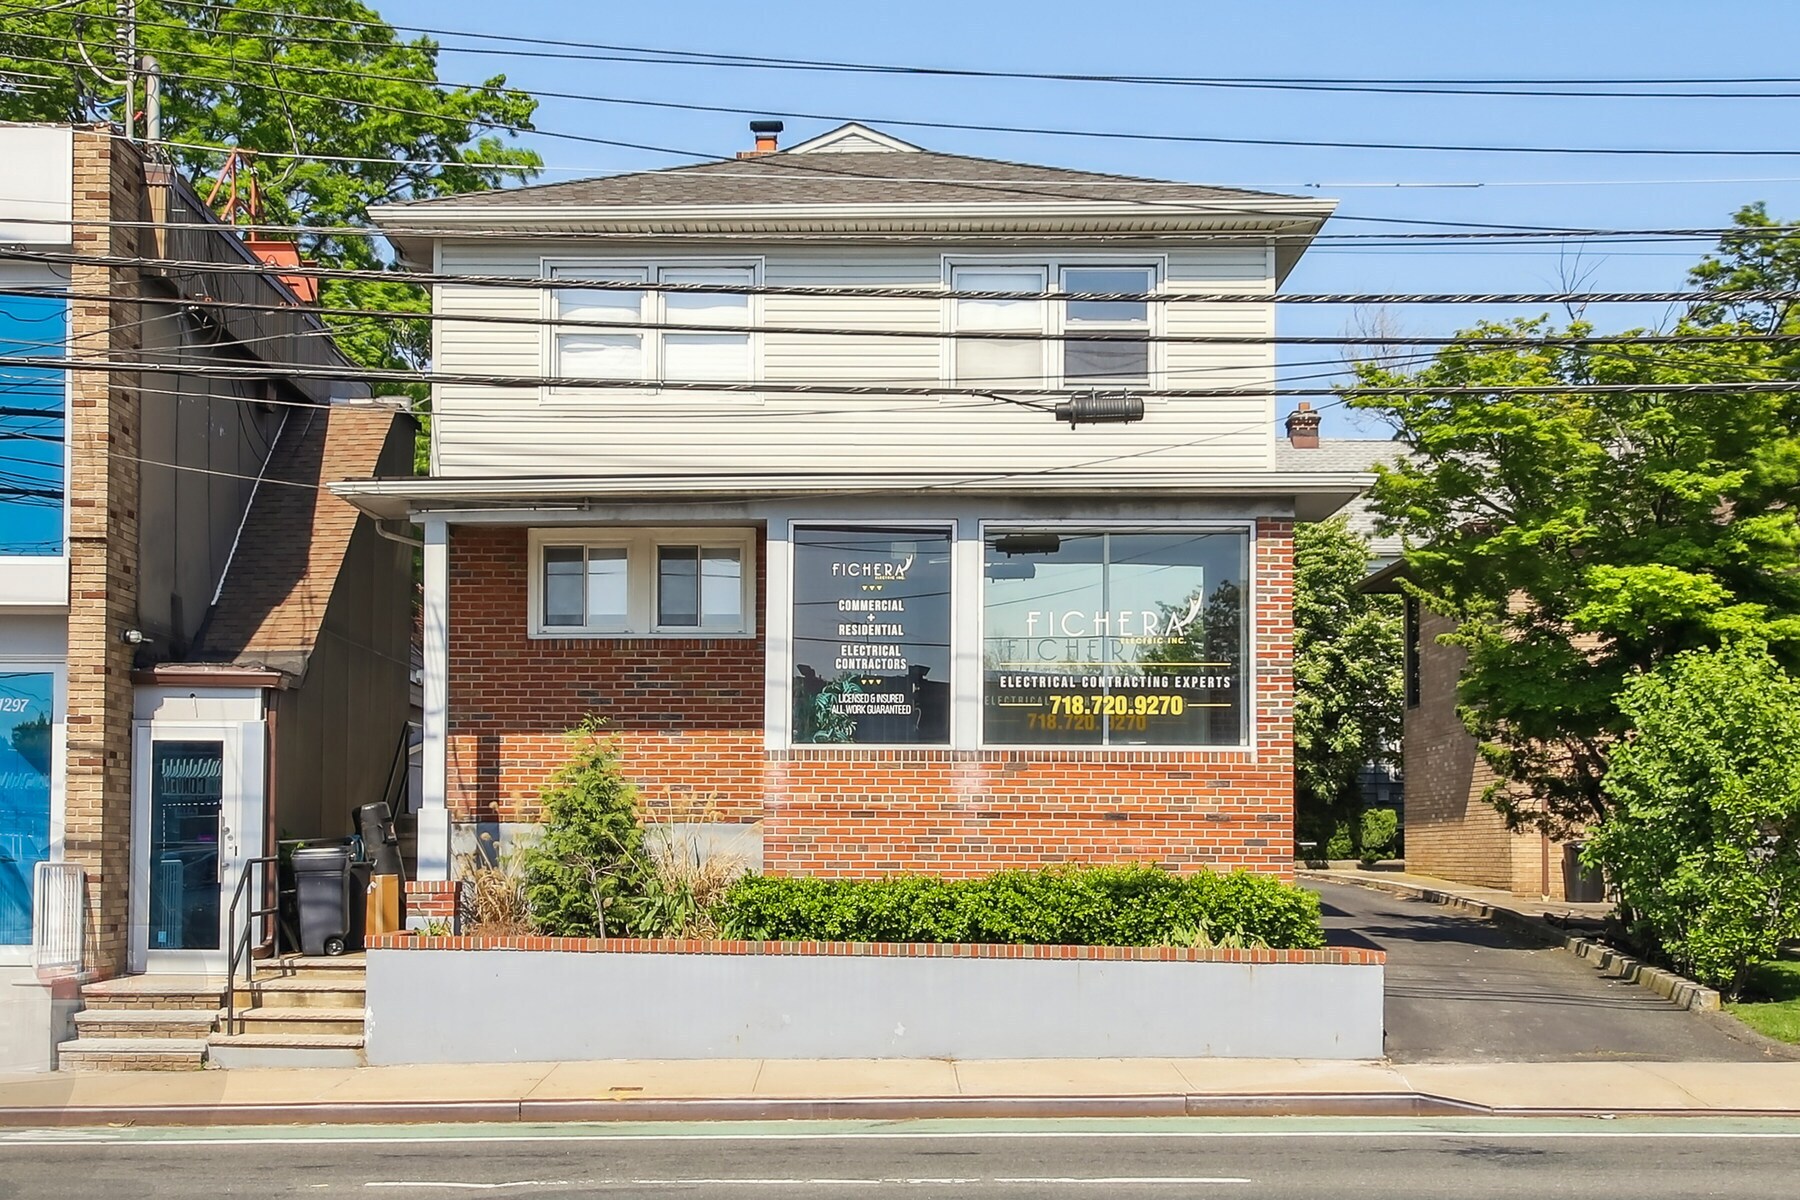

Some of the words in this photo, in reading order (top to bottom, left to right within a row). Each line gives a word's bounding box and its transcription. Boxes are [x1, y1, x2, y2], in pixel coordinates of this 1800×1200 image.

[832, 562, 905, 576] FICHERA
[838, 599, 904, 611] COMMERCIAL
[1026, 610, 1184, 637] FICHERA
[838, 624, 904, 636] RESIDENTIAL
[841, 645, 901, 656] ELECTRICAL
[835, 658, 907, 670] CONTRACTORS
[1000, 676, 1076, 688] ELECTRICAL
[1082, 676, 1169, 688] CONTRACTING
[1174, 676, 1231, 688] EXPERTS
[838, 693, 869, 703] LICENSED
[870, 693, 875, 703] &
[876, 693, 904, 703] INSURED
[831, 704, 844, 714] ALL
[845, 704, 866, 714] WORK
[866, 704, 911, 714] GUARANTEED
[1050, 695, 1183, 715] 718.720.9270
